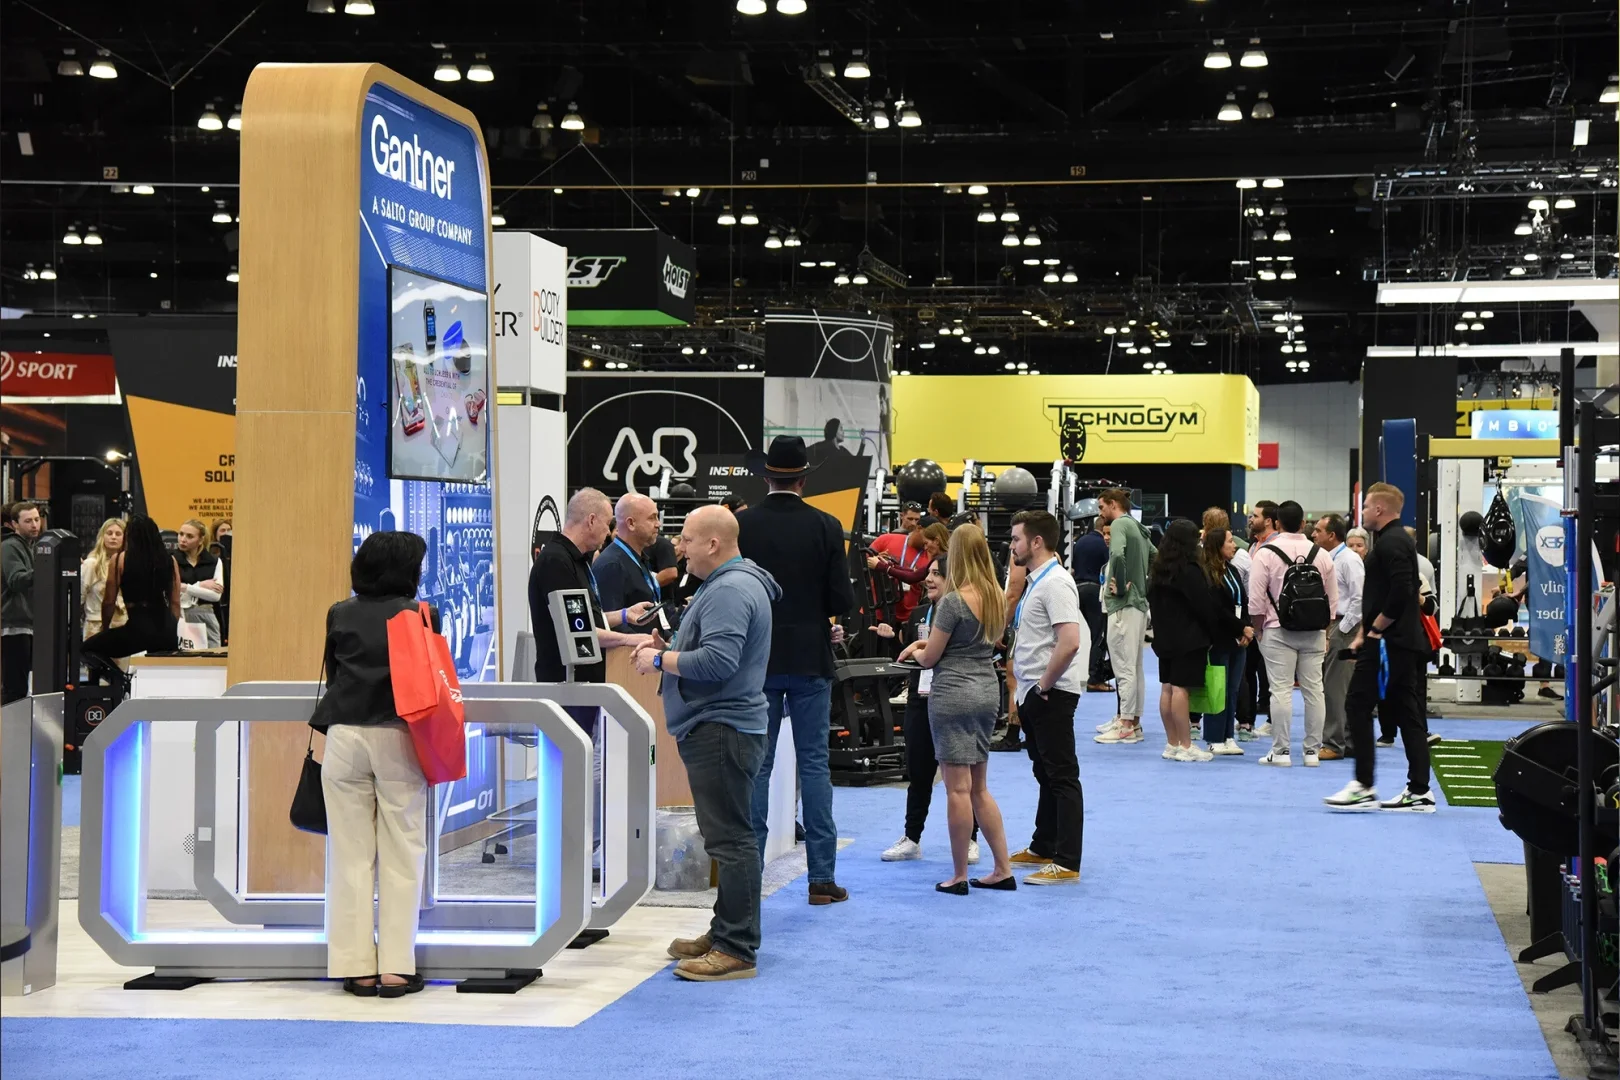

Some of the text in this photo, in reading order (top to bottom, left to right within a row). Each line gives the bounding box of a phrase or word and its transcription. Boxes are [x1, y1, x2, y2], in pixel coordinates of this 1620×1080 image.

[371, 114, 455, 200] Gantner
[105, 168, 116, 177] 22
[1072, 167, 1084, 176] 19
[372, 195, 472, 246] A SALTO GROUP COMPANY
[567, 258, 620, 279] ST
[664, 262, 690, 292] HOIST
[17, 361, 77, 380] SPORT
[709, 466, 753, 477] INSIGH
[478, 789, 493, 810] 01
